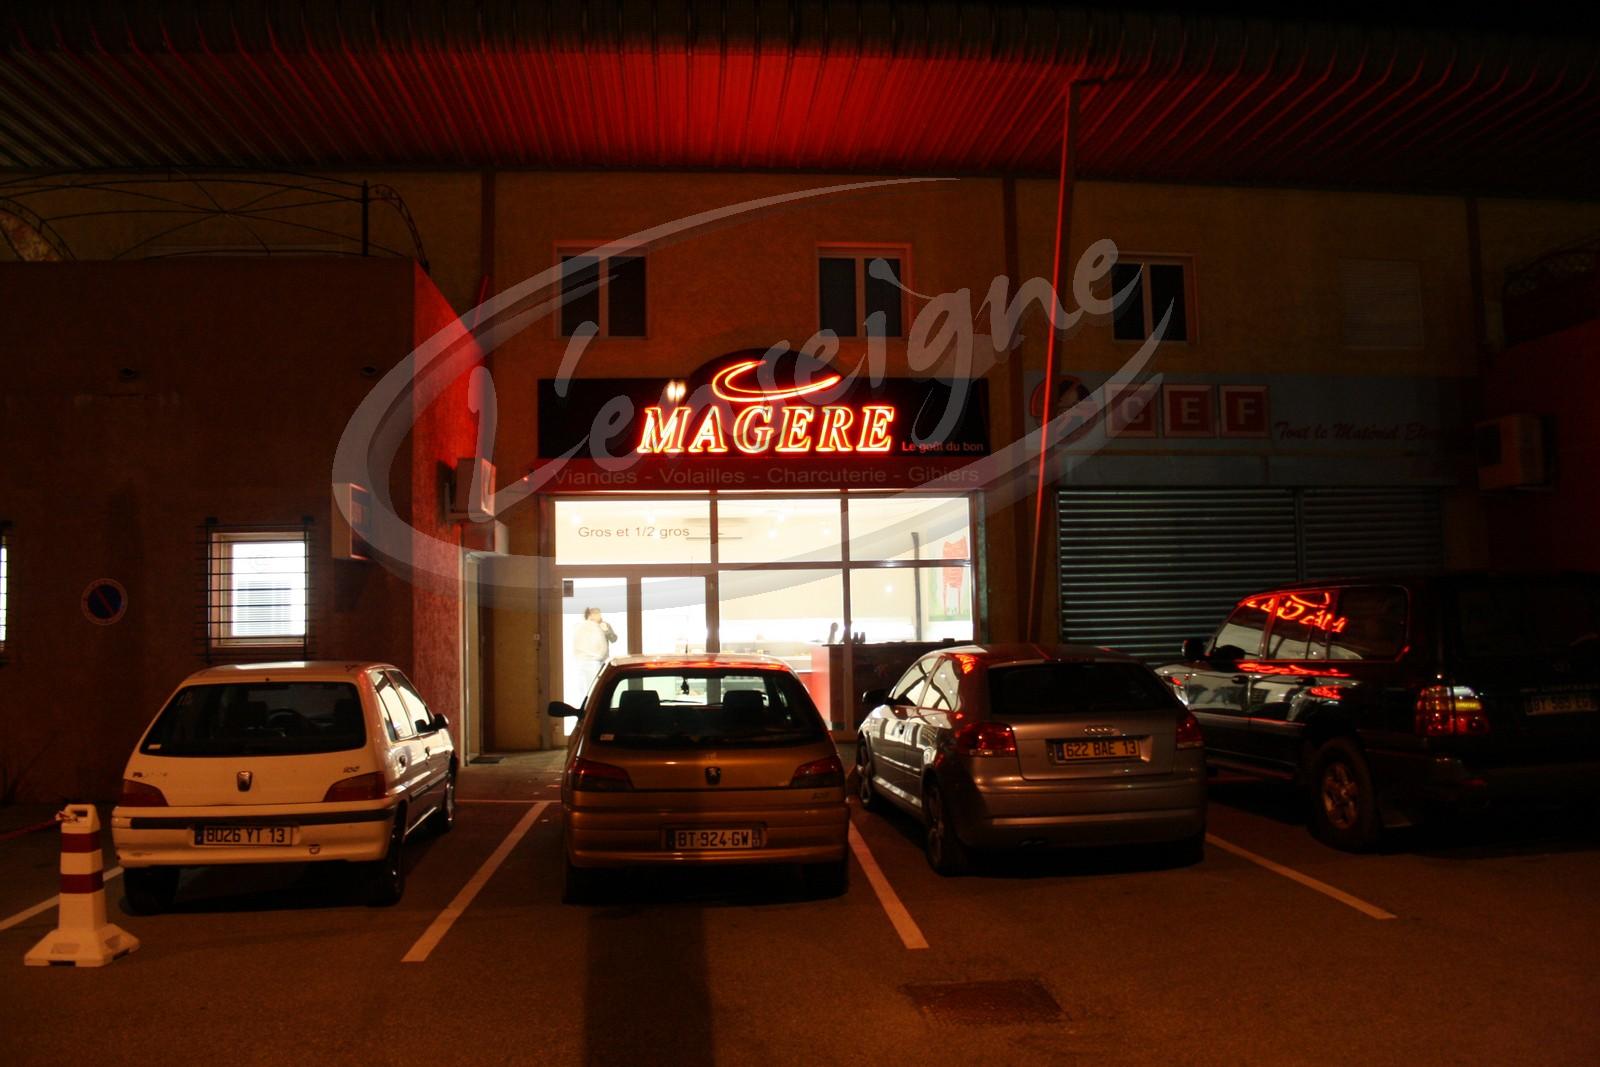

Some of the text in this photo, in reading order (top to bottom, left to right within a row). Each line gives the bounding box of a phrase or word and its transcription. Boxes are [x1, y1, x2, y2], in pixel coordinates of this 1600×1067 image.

[637, 405, 895, 453] MAGERE
[902, 441, 916, 452] Le
[946, 441, 960, 452] du
[963, 441, 984, 452] bon
[554, 469, 637, 485] Viandes
[659, 467, 745, 484] Volailles
[767, 466, 886, 484] Charcuterie
[908, 465, 979, 483] Gibiers
[578, 526, 690, 540] Gros et 1/2 gros
[1066, 740, 1137, 758] 622 BAE 13
[206, 826, 285, 843] 8026 YT 13
